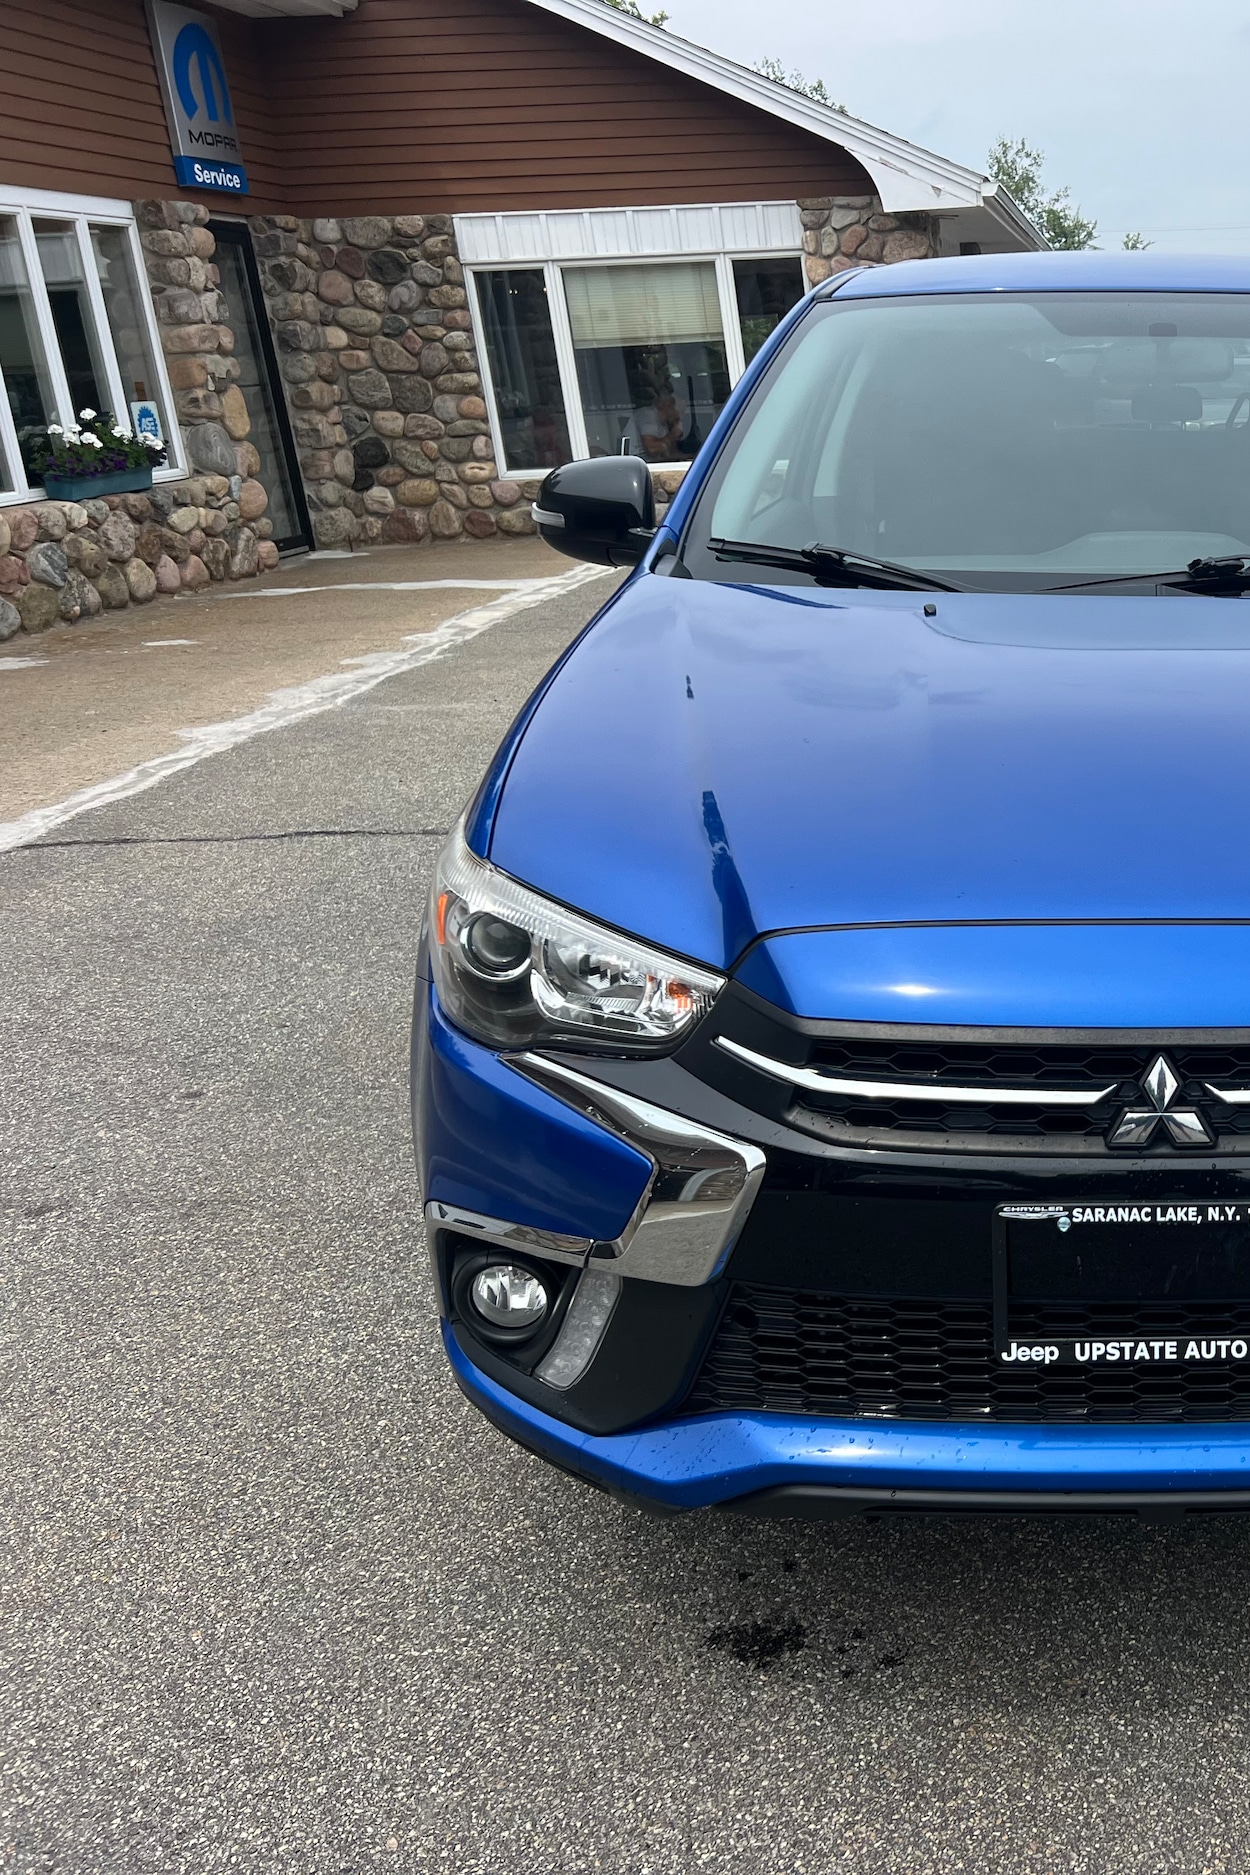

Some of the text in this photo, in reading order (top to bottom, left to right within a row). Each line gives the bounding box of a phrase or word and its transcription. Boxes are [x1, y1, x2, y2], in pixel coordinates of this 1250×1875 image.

[188, 129, 237, 152] MOPAR
[193, 163, 241, 189] Service
[141, 417, 156, 432] ASE
[1072, 1206, 1241, 1224] SARANAC LAKE, N.Y.
[1001, 1342, 1060, 1364] Jeep
[1074, 1340, 1248, 1361] UPSTATE AUTO
